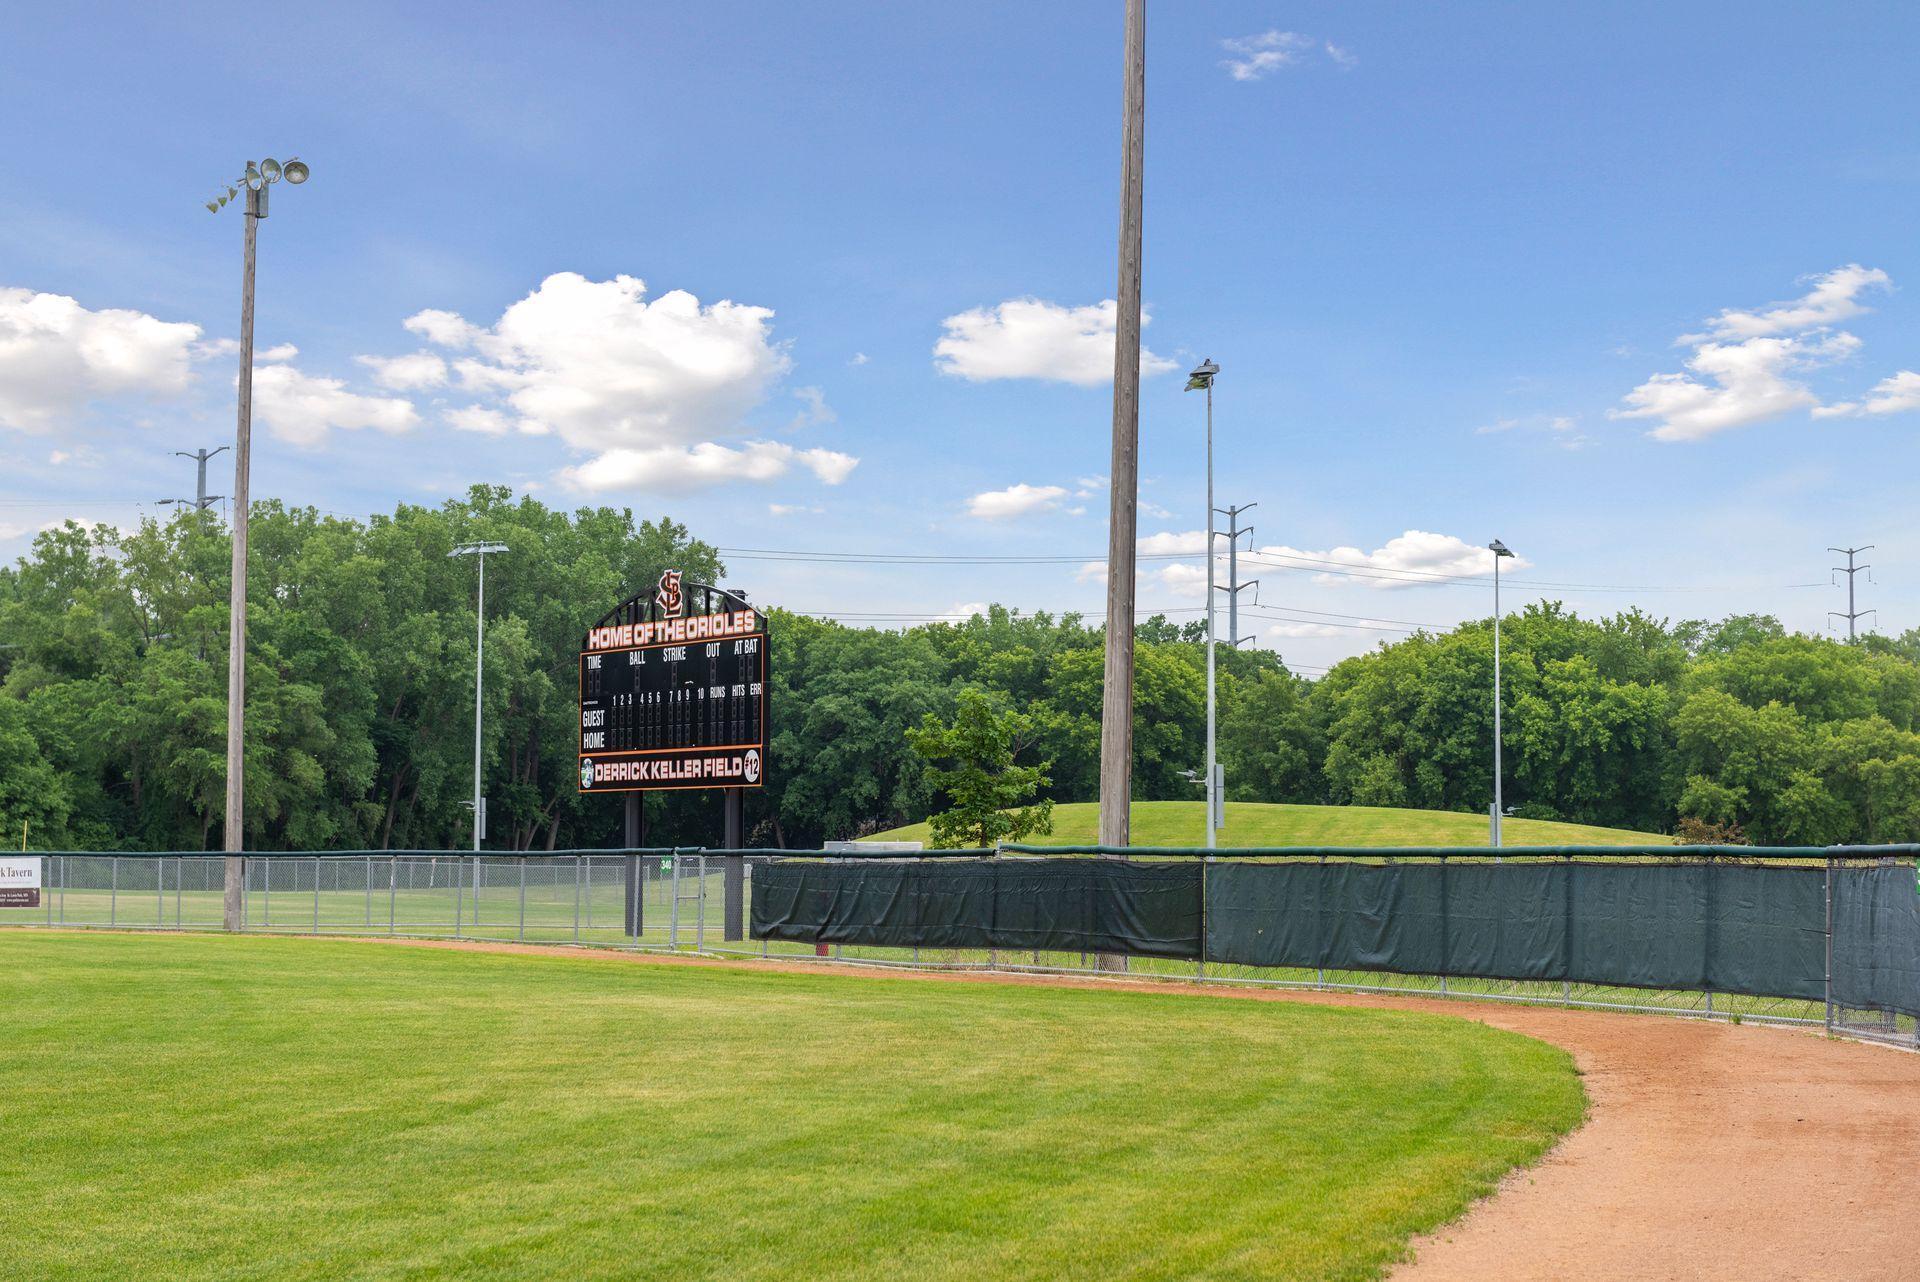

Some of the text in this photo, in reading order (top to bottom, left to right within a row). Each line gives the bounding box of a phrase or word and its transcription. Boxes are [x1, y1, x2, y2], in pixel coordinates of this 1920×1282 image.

[589, 610, 755, 649] HOME OF THE ORIOLES
[706, 643, 720, 658] OUT
[734, 639, 758, 654] AT BAT
[630, 651, 645, 665] BALL
[663, 647, 686, 662] STRIKE
[587, 655, 601, 670] TIME
[613, 682, 762, 706] 1 2 3 4 5 6 7 8 9 10 RUNS HITS ERR
[583, 709, 605, 727] GUEST
[584, 732, 604, 749] HOME
[595, 757, 742, 782] DERRICK KELLER FIELD
[6, 867, 32, 878] Tavern
